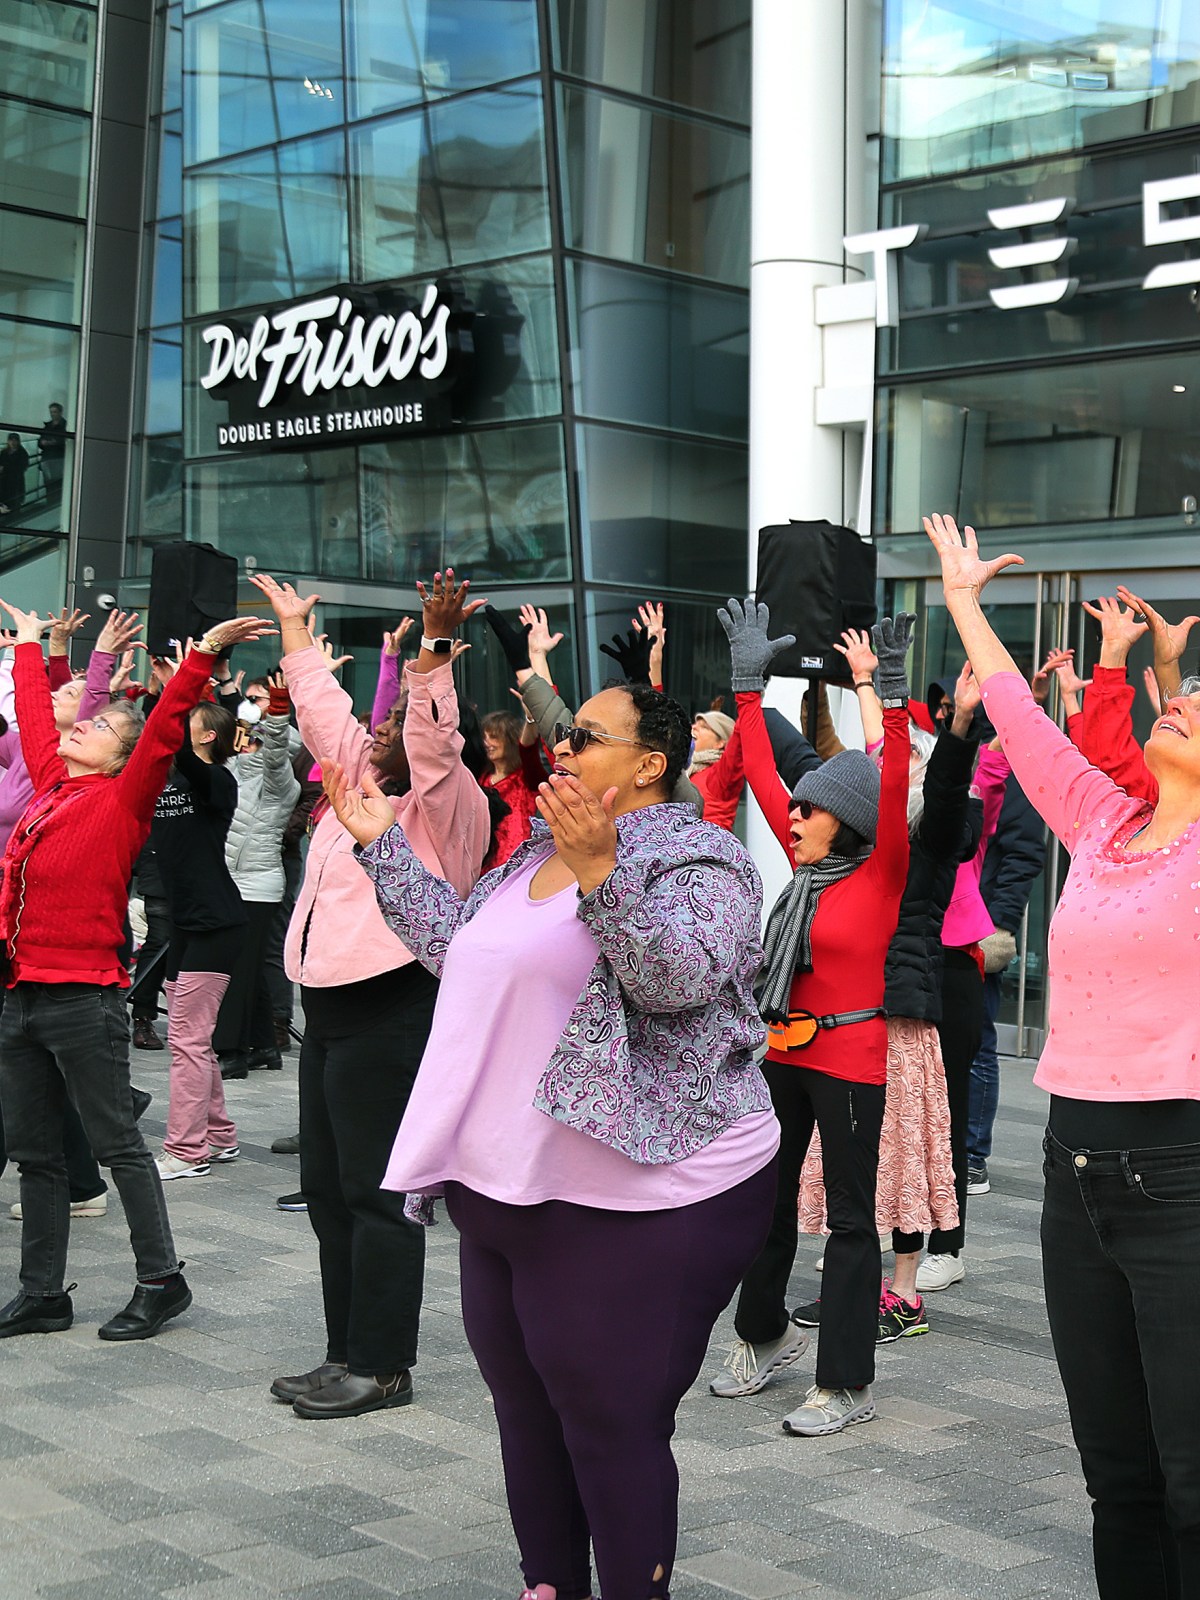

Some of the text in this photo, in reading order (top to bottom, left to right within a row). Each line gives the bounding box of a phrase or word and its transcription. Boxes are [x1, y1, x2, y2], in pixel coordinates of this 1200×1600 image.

[200, 283, 450, 408] Del Frisco's
[219, 402, 423, 445] DOUBLE EAGLE STEAKHOUSE
